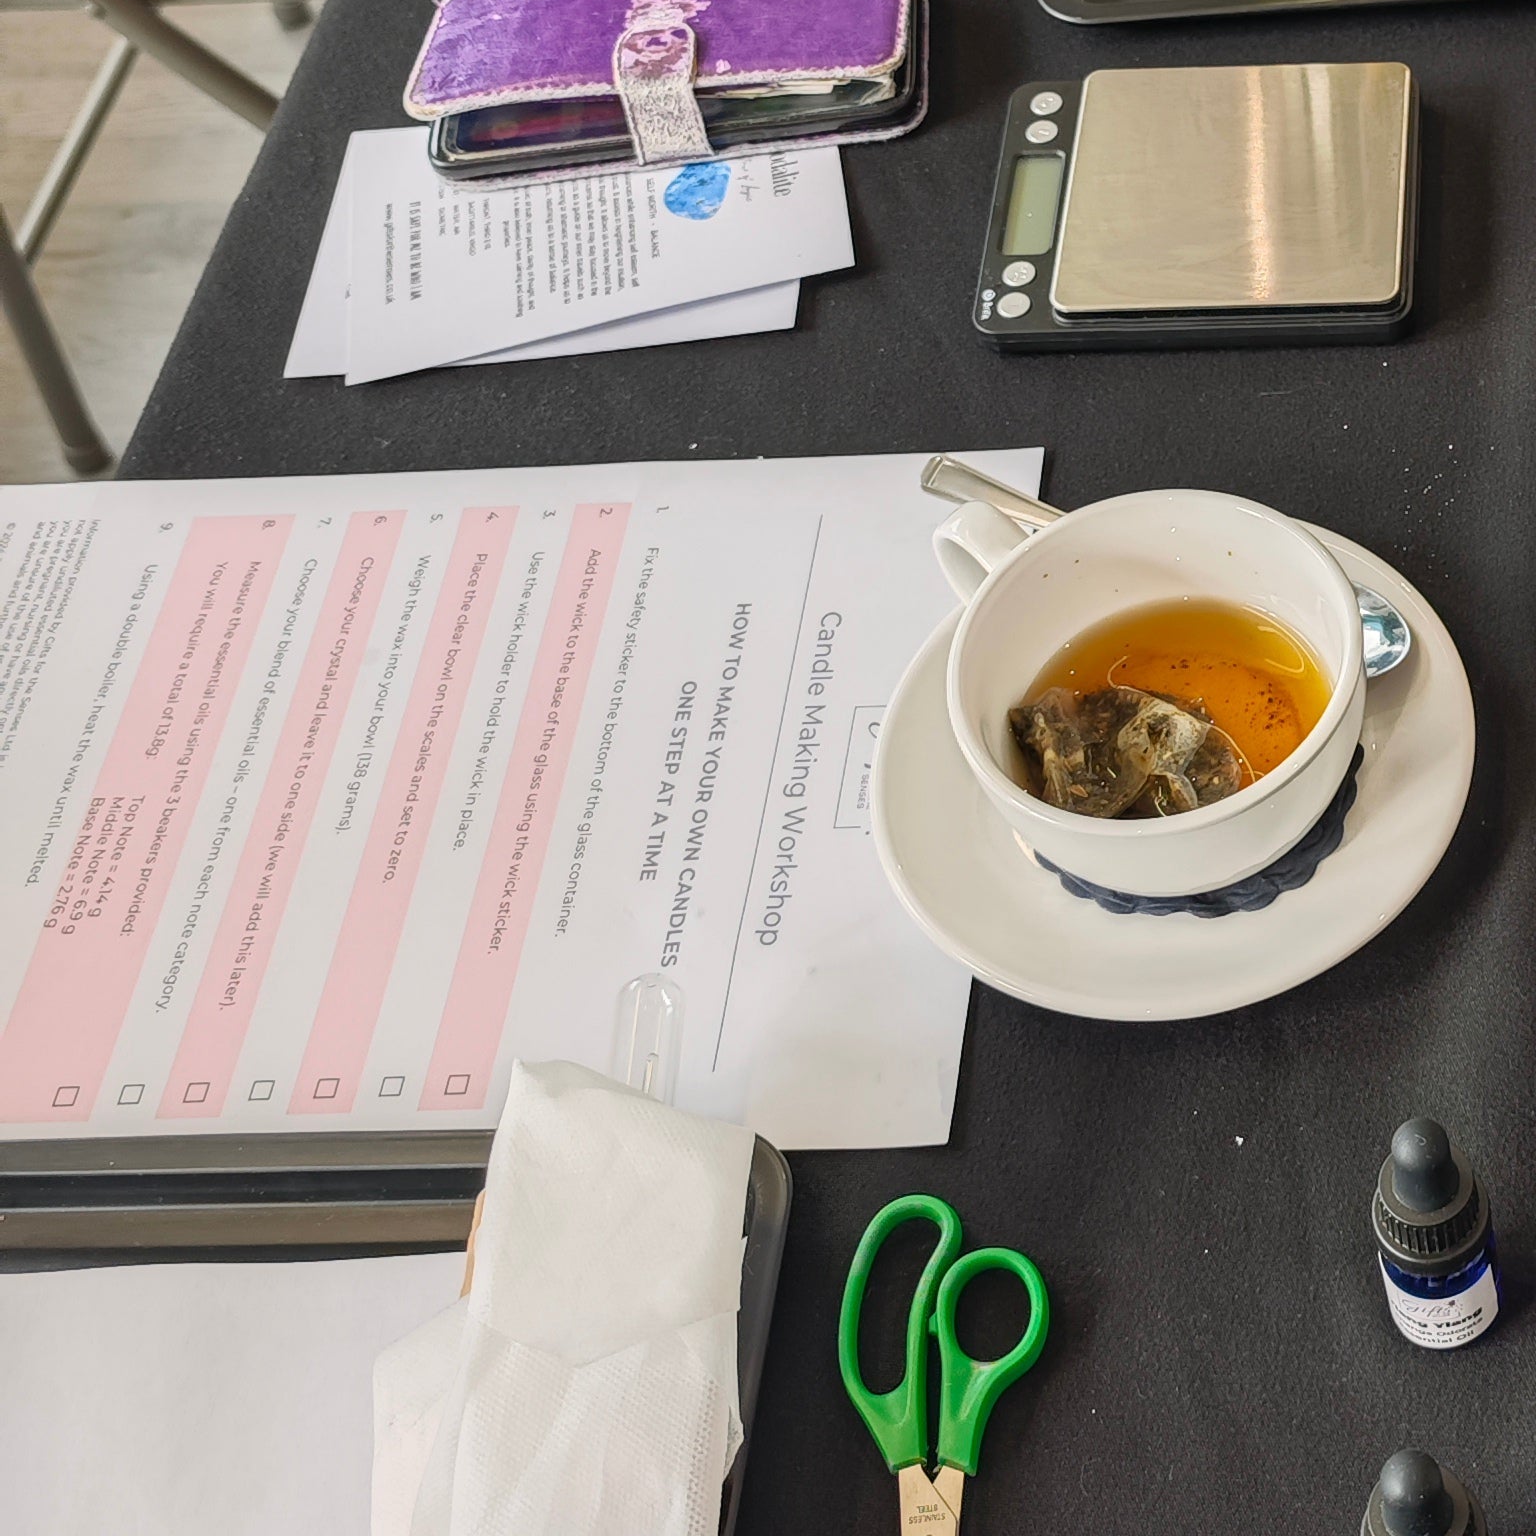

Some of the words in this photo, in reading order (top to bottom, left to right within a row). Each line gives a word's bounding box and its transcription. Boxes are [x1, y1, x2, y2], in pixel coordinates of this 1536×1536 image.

[769, 151, 800, 198] odalite
[429, 512, 444, 524] 5.
[598, 506, 614, 518] 2.
[655, 505, 670, 514] 1.
[583, 547, 602, 576] Add
[643, 546, 660, 566] Fix
[407, 554, 432, 597] Weigh
[577, 577, 595, 600] the
[637, 567, 654, 590] the
[399, 599, 418, 622] the
[568, 601, 588, 633] wick
[625, 591, 647, 631] safety
[727, 602, 753, 650] HOW
[391, 623, 409, 651] wax
[565, 634, 580, 649] to
[382, 652, 403, 680] into
[558, 650, 576, 674] the
[616, 632, 638, 676] sticker
[721, 654, 742, 681] TO
[806, 611, 843, 696] Candle
[373, 681, 392, 712] your
[549, 676, 571, 709] base
[612, 678, 627, 694] to
[673, 680, 698, 722] ONE
[545, 710, 560, 726] of
[605, 696, 624, 720] the
[707, 685, 736, 742] MAKE
[361, 714, 385, 749] bowl
[538, 726, 557, 752] the
[592, 722, 619, 775] bottom
[663, 726, 688, 775] STEP
[781, 704, 827, 798] Making
[352, 751, 374, 779] (138
[528, 753, 549, 790] glass
[694, 745, 723, 803] YOUR
[589, 778, 604, 793] of
[655, 780, 676, 807] AT
[334, 780, 361, 835] grams).
[514, 792, 539, 832] using
[582, 794, 600, 820] the
[650, 811, 669, 828] A
[511, 835, 530, 861] the
[572, 821, 593, 860] glass
[682, 808, 709, 862] OWN
[638, 830, 666, 882] TIME
[500, 862, 521, 899] wick
[754, 805, 808, 946] Workshop
[553, 862, 582, 938] container.
[486, 900, 511, 955] sticker.
[659, 867, 696, 968] CANDLES
[1433, 1306, 1483, 1329] Ylang
[908, 1513, 946, 1524] STAINLESS
[917, 1504, 938, 1513] STEEL
